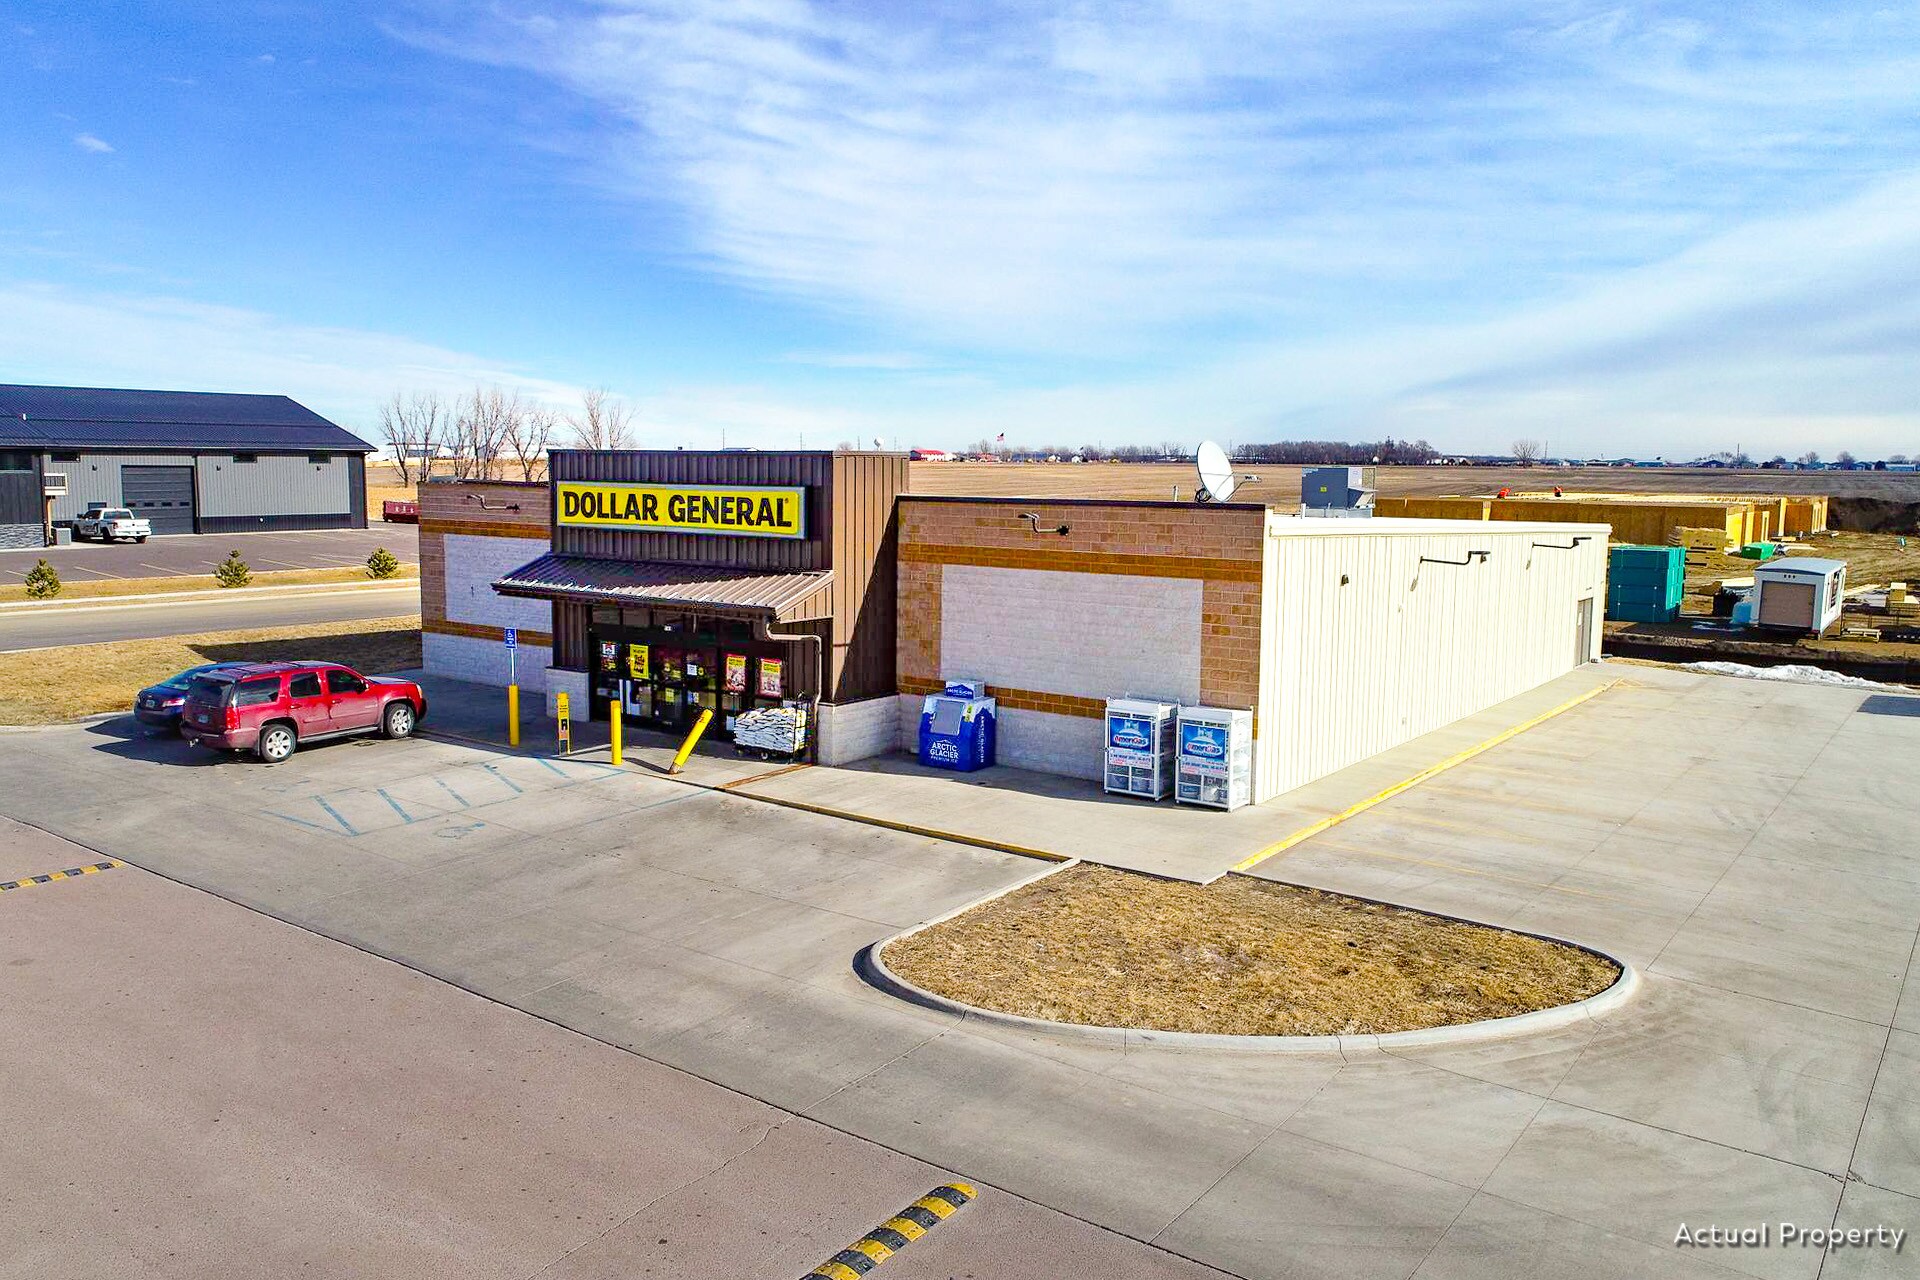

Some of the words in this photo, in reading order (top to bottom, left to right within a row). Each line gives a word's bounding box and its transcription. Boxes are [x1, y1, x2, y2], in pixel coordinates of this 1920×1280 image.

[563, 491, 658, 518] DOLLAR
[668, 495, 792, 527] GENERAL
[931, 742, 957, 752] ARCTIC
[930, 749, 959, 759] GLACIER
